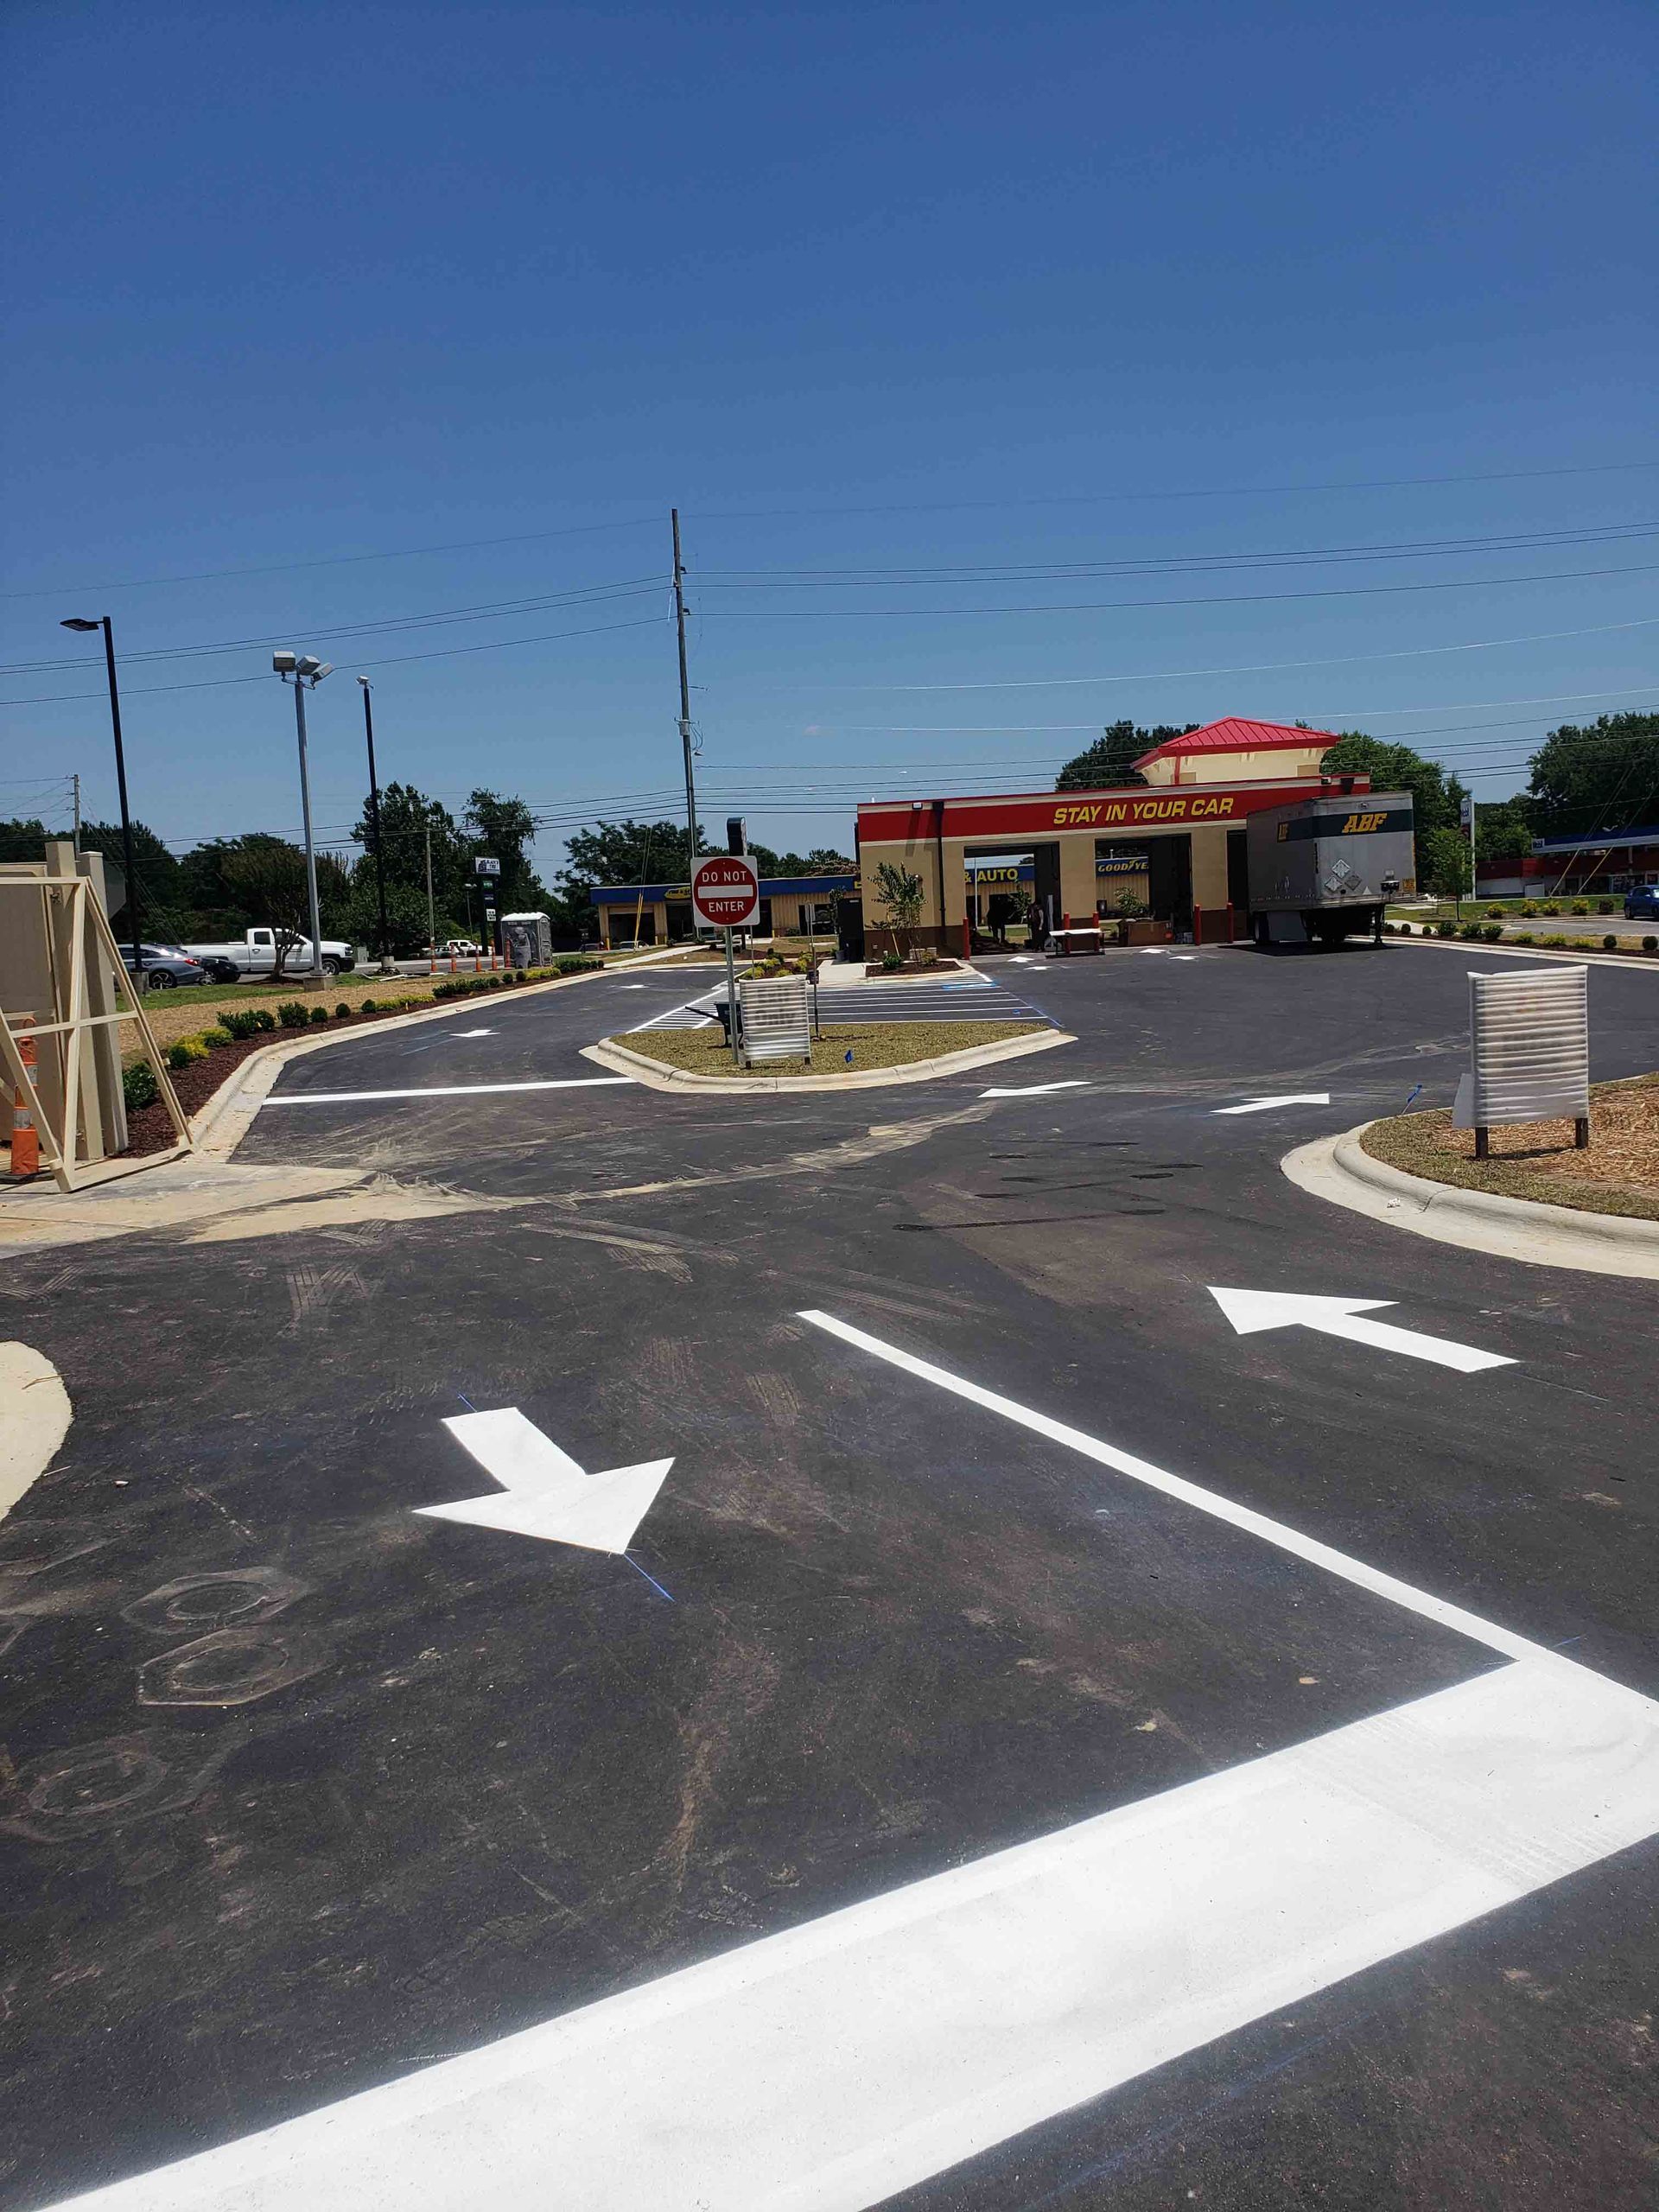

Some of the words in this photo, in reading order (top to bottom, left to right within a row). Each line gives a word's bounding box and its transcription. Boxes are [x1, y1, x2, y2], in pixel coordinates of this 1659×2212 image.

[1054, 805, 1103, 824] STAY
[1106, 804, 1128, 821] IN
[1134, 801, 1186, 819] YOUR
[1191, 798, 1234, 816] CAR
[1342, 812, 1387, 834] ABF
[1098, 861, 1149, 872] GOODYE
[702, 872, 718, 882] DO
[724, 871, 747, 881] NOT
[976, 868, 1018, 882] AUTO
[709, 901, 746, 912] ENTER
